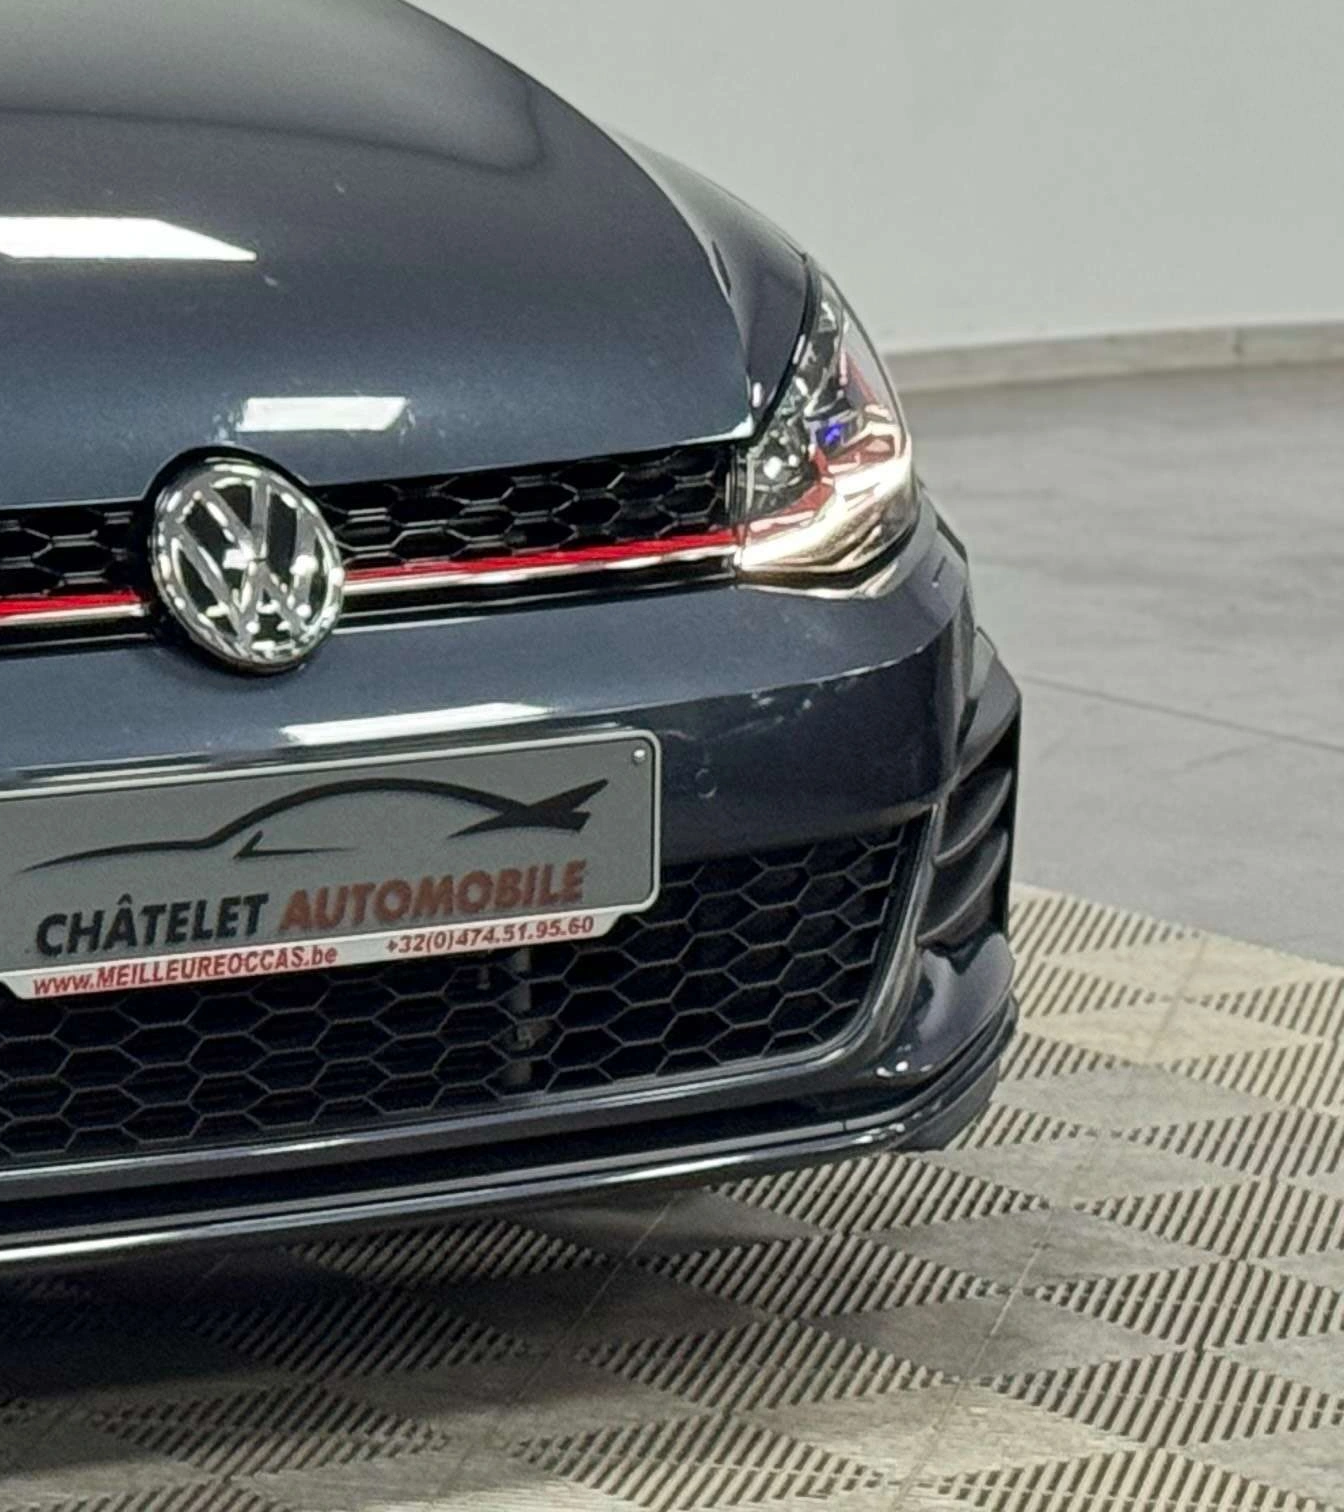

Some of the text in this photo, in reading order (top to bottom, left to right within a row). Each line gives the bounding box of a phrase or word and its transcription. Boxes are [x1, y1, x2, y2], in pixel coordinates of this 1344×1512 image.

[35, 859, 587, 957] CHÂTELET AUTOMOBILE
[32, 915, 594, 995] www.MEILLEUREOCCAS.be +32(0)474.51.95.60
